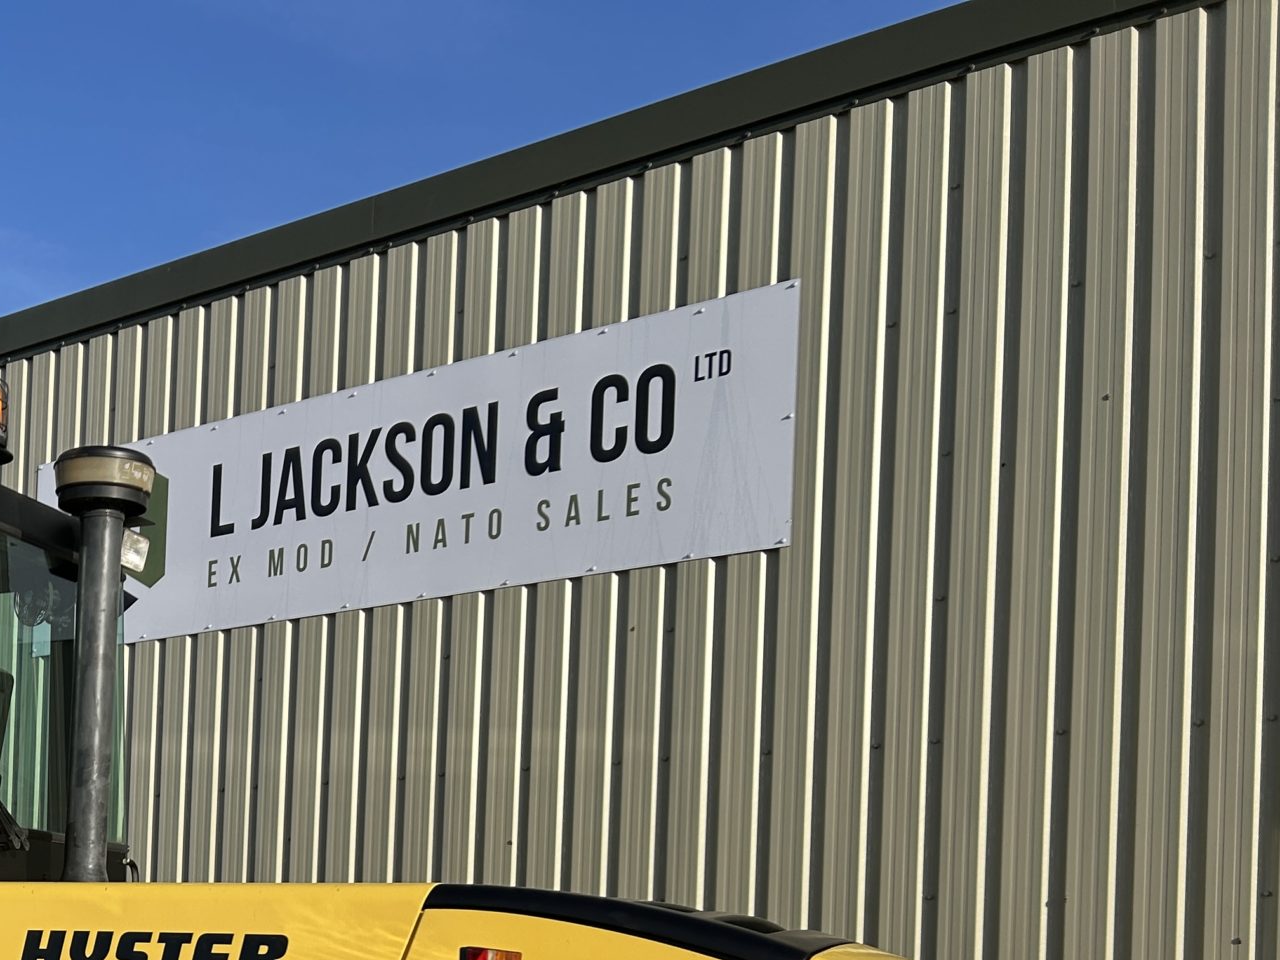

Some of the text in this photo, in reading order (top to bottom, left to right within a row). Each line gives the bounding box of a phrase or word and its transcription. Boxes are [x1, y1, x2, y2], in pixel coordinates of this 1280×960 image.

[210, 349, 732, 538] L JACKSON & CO LTD
[207, 477, 673, 588] EX MOD / NATO SALES
